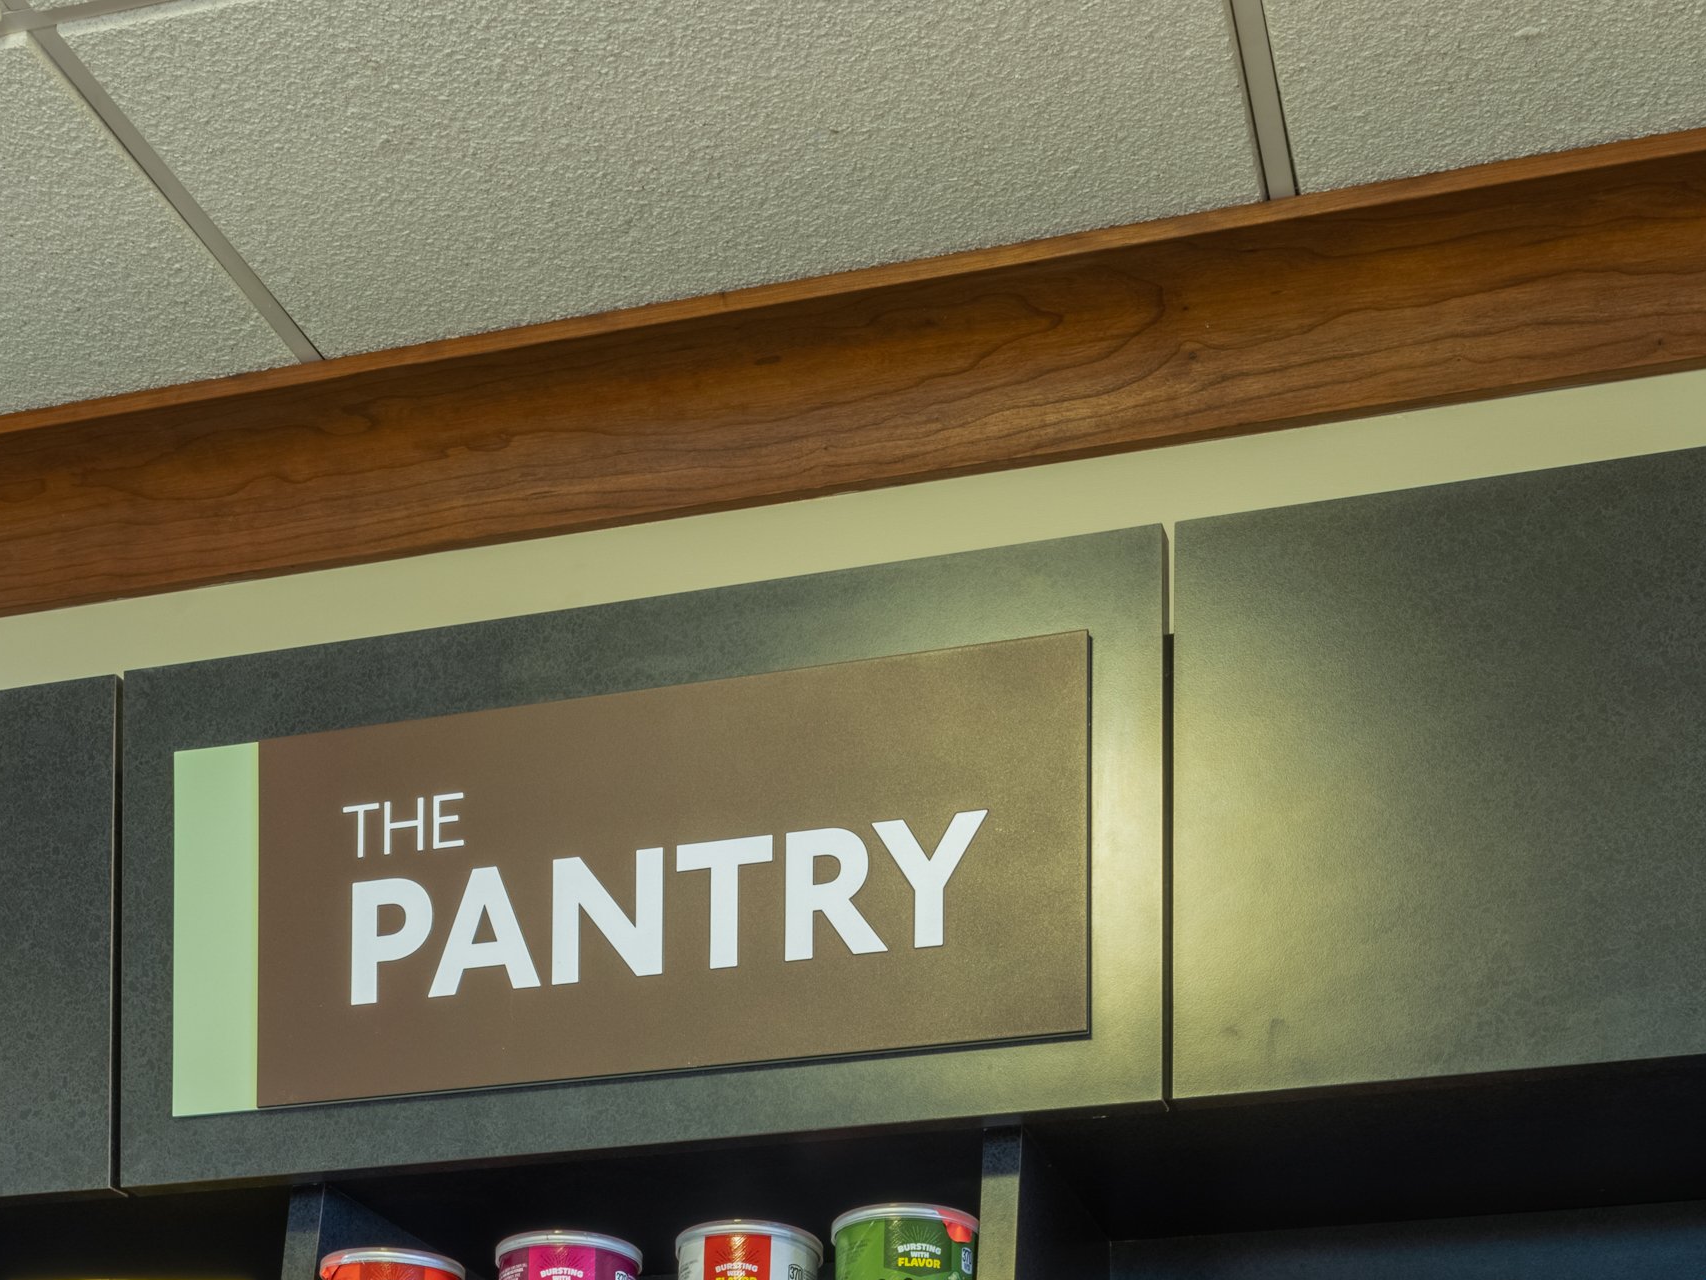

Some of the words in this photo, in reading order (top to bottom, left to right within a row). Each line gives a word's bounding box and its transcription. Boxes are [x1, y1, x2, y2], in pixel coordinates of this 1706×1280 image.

[343, 792, 464, 858] THE
[351, 809, 988, 1005] PANTRY
[540, 1269, 583, 1280] BURSTING
